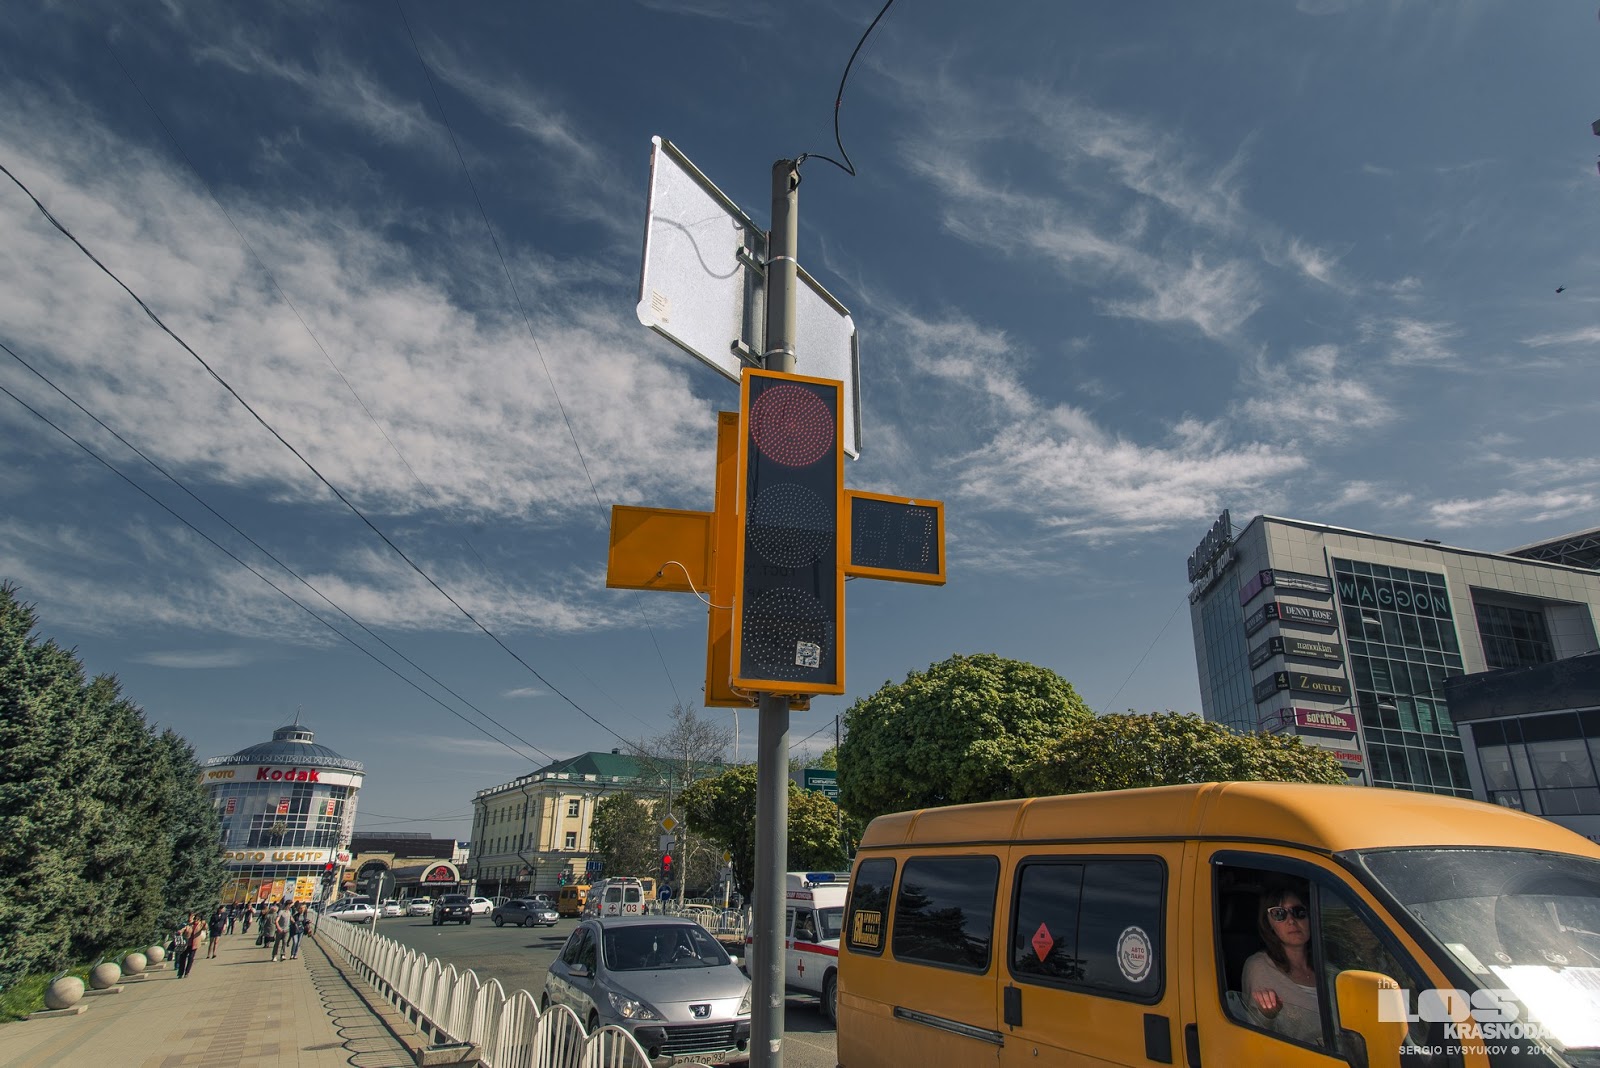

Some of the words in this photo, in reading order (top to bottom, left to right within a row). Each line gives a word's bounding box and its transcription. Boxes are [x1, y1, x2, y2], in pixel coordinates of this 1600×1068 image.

[1268, 605, 1275, 613] 3
[1285, 605, 1311, 618] DENNY
[1312, 609, 1333, 621] ROSE
[1278, 673, 1286, 684] 4
[1300, 675, 1310, 689] Z
[1312, 682, 1343, 693] OUTLET
[1306, 711, 1348, 727] БОГАТЫРЬ
[208, 769, 236, 780] ФОТО
[256, 767, 321, 783] Kodak
[271, 851, 323, 863] ЦЕНТР
[626, 904, 638, 913] 03
